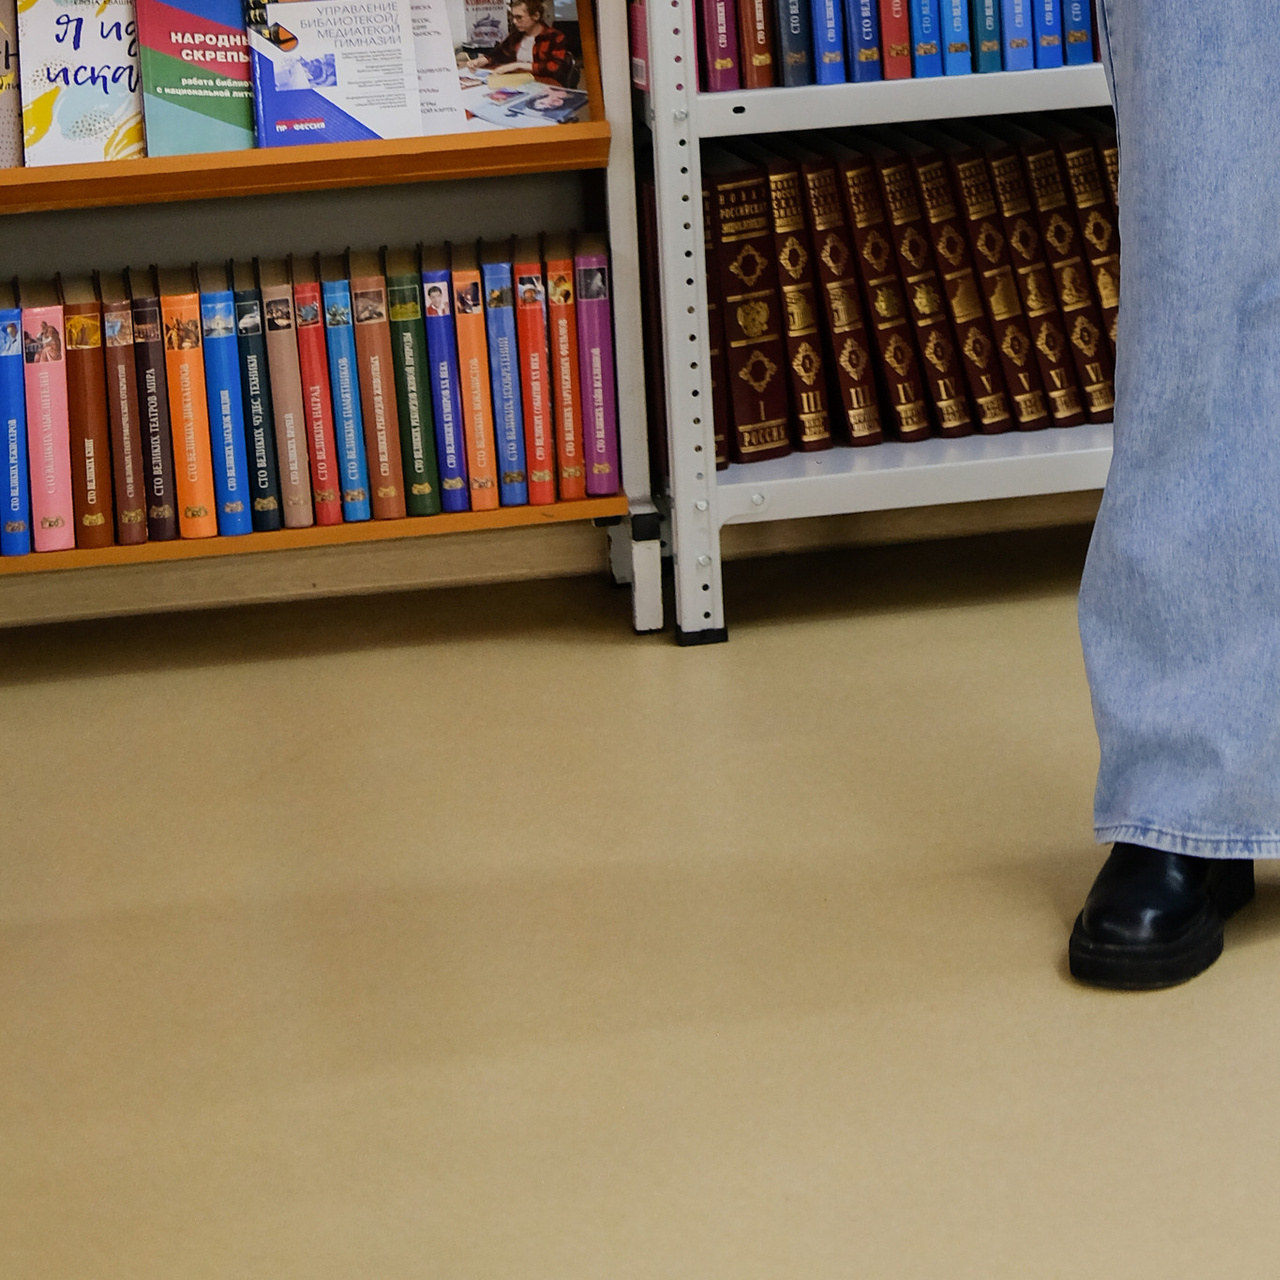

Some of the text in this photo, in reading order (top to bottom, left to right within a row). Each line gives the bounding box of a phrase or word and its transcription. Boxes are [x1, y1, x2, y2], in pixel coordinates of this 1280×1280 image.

[316, 2, 399, 16] УПРАВЛЕНИЕ
[317, 24, 401, 39] МЕДИАТЕКОЙ
[860, 19, 873, 40] СТО
[333, 35, 402, 50] ГИМНАЗИИ
[181, 78, 252, 88] работа библио
[246, 354, 268, 488] СТО ВЕЛИКИХ ЧУДЕС ТЕХНИКИ
[146, 368, 164, 496] СТО ВЕЛИКИХ ТЕАТРОВ МИРА
